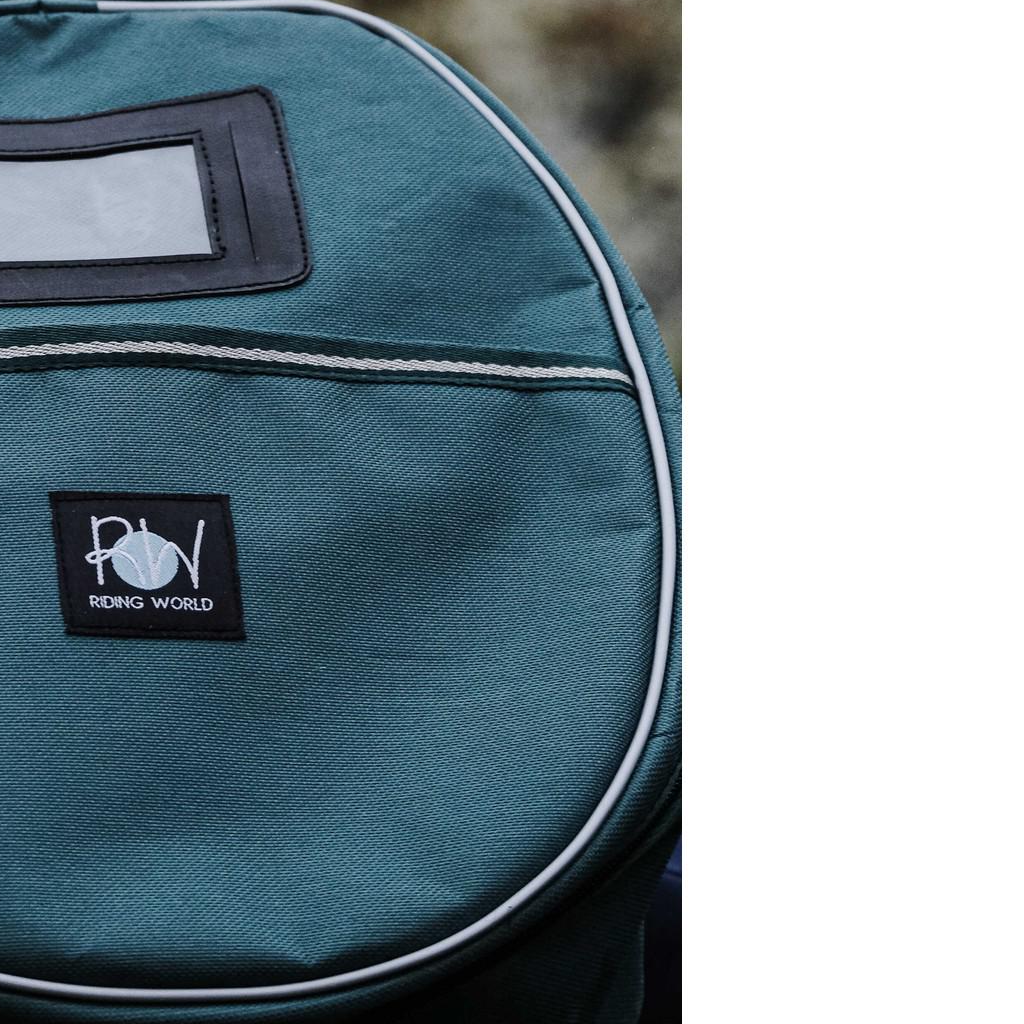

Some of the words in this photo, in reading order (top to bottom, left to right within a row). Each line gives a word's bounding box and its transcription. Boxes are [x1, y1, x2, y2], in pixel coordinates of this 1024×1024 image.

[84, 515, 205, 589] RW
[88, 594, 145, 609] RIDING
[150, 596, 214, 612] WORLD
